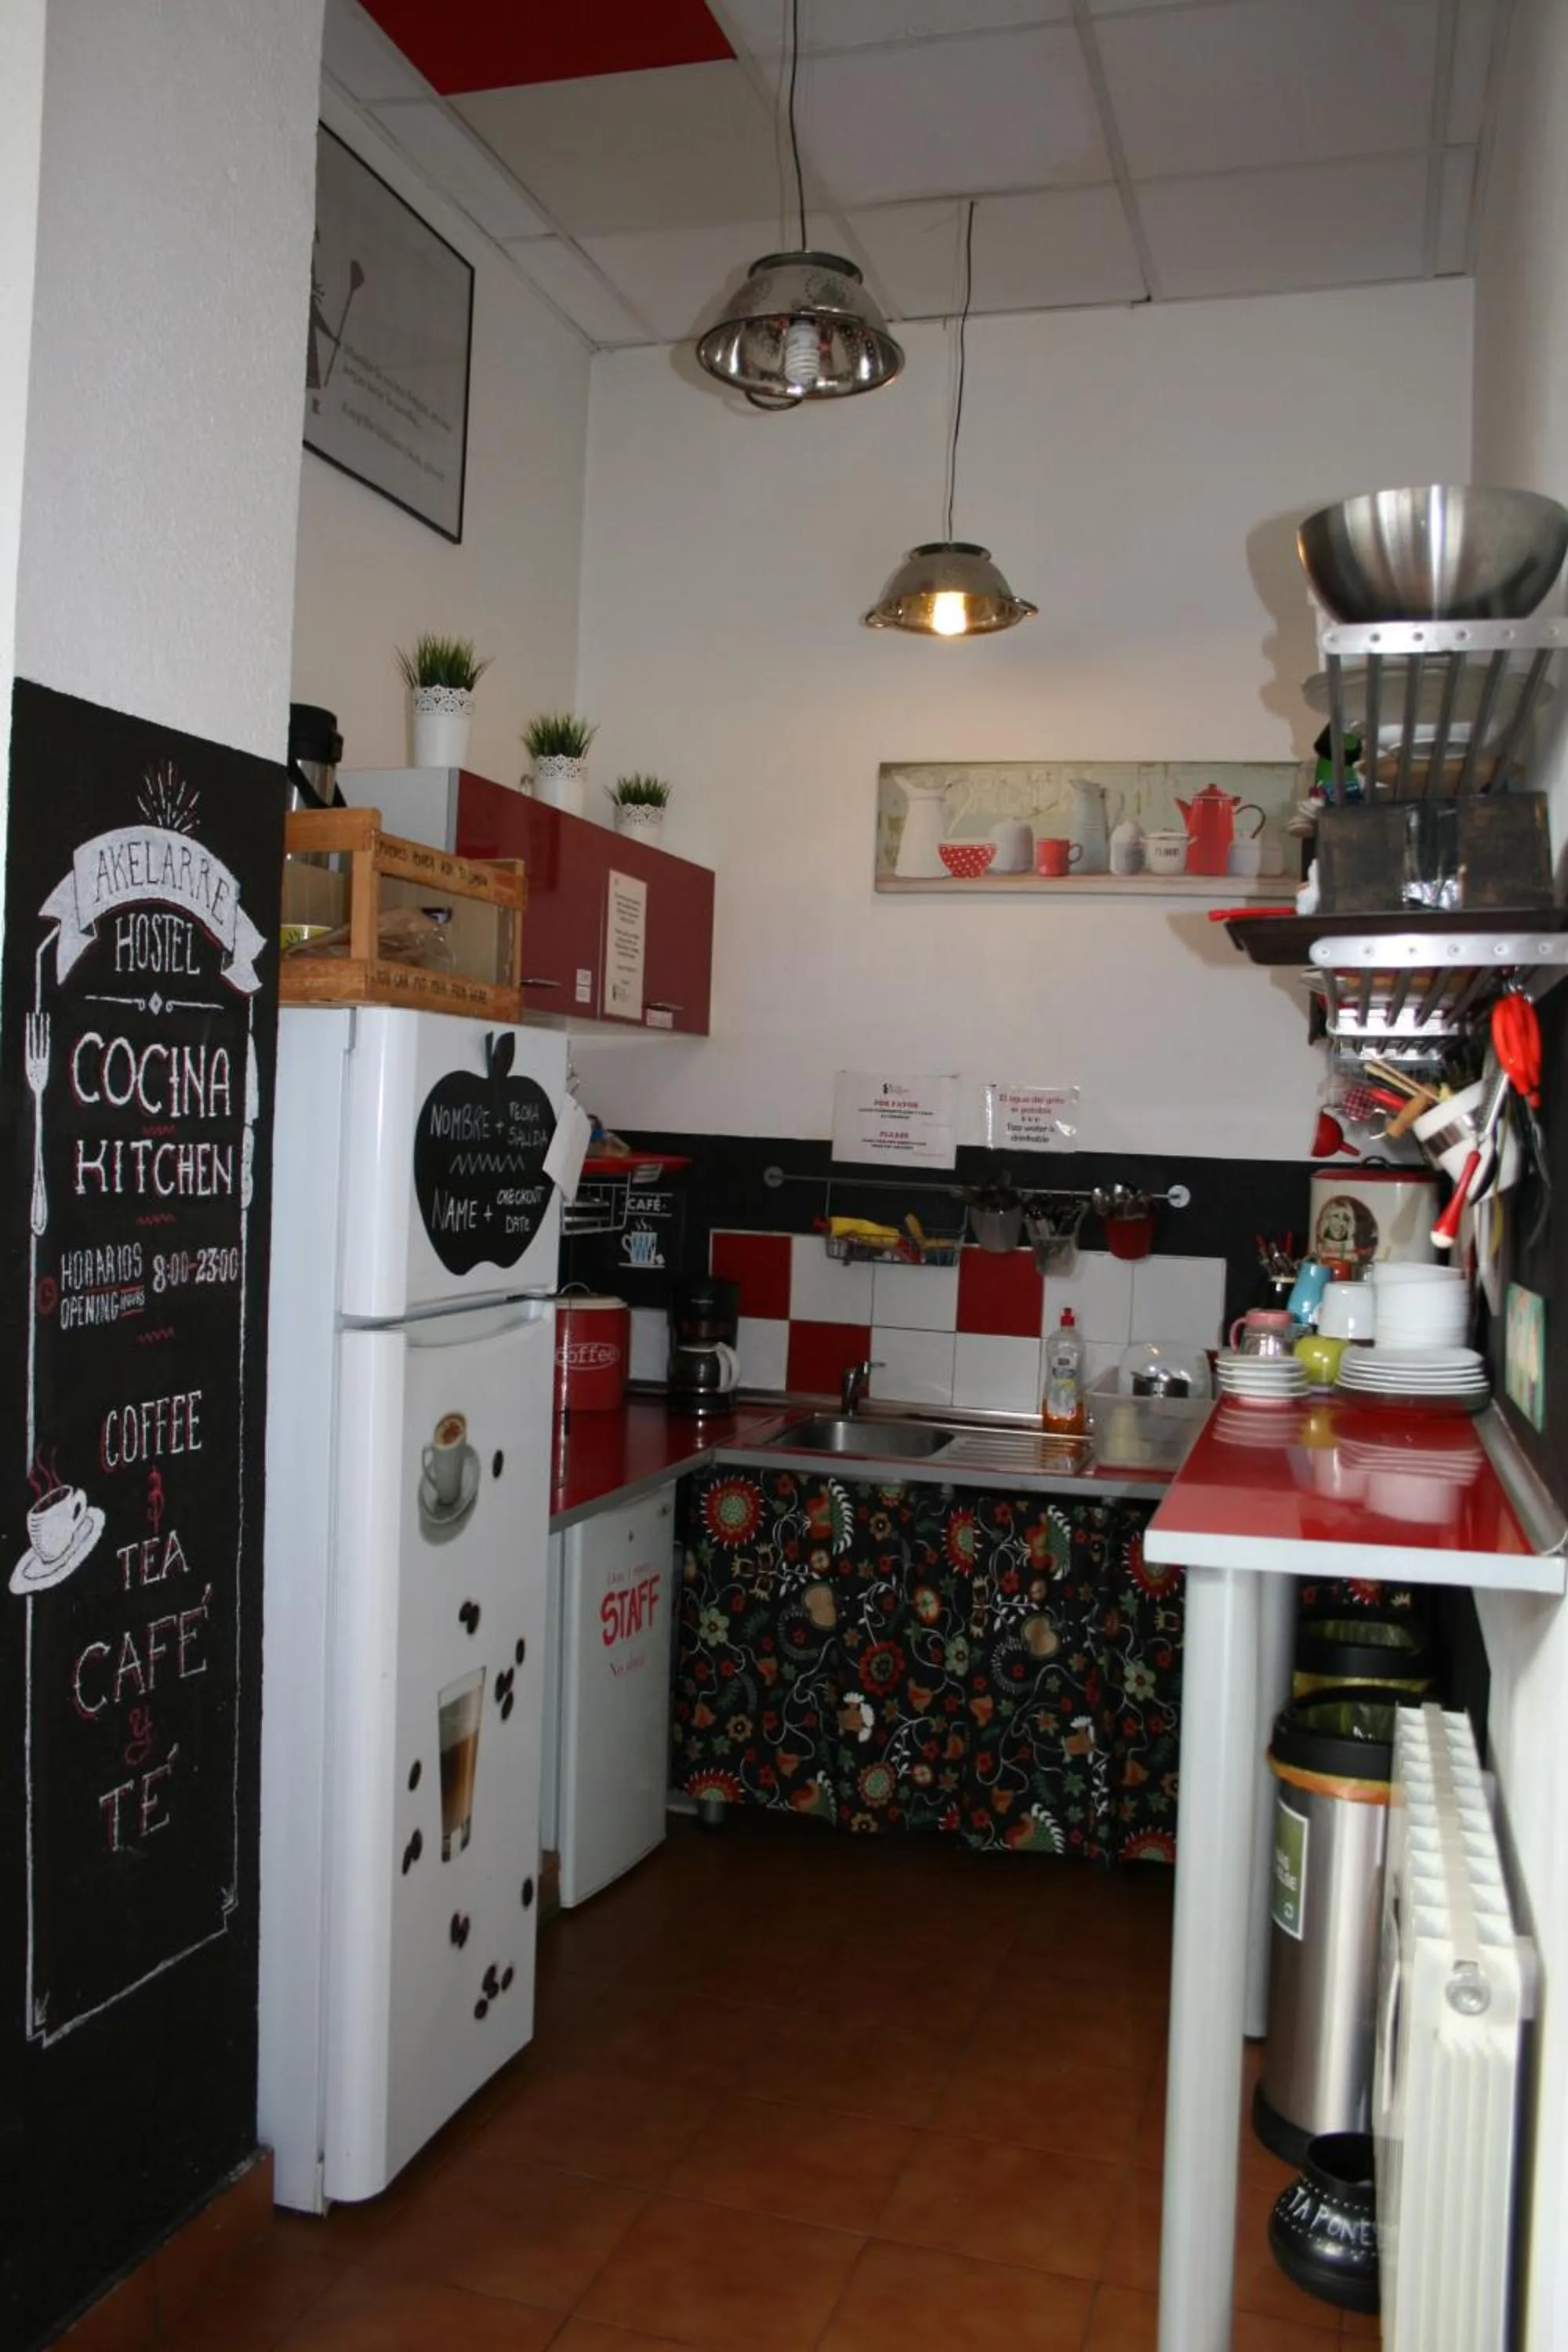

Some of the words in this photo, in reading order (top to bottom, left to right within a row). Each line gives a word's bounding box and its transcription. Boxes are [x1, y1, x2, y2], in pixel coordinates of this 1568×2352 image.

[95, 840, 230, 927] AKELARRE
[114, 913, 200, 975] HOSTEL
[71, 1032, 231, 1118] COCINA
[430, 1102, 490, 1142] NOMBRE
[75, 1139, 233, 1196] KITCHEN
[432, 1185, 477, 1233] NAME
[60, 1241, 142, 1290] HORARIOS
[60, 1292, 118, 1330] OPENING
[103, 1389, 201, 1470] COFFEE
[117, 1530, 191, 1591] TEA
[600, 1573, 661, 1646] STAFF
